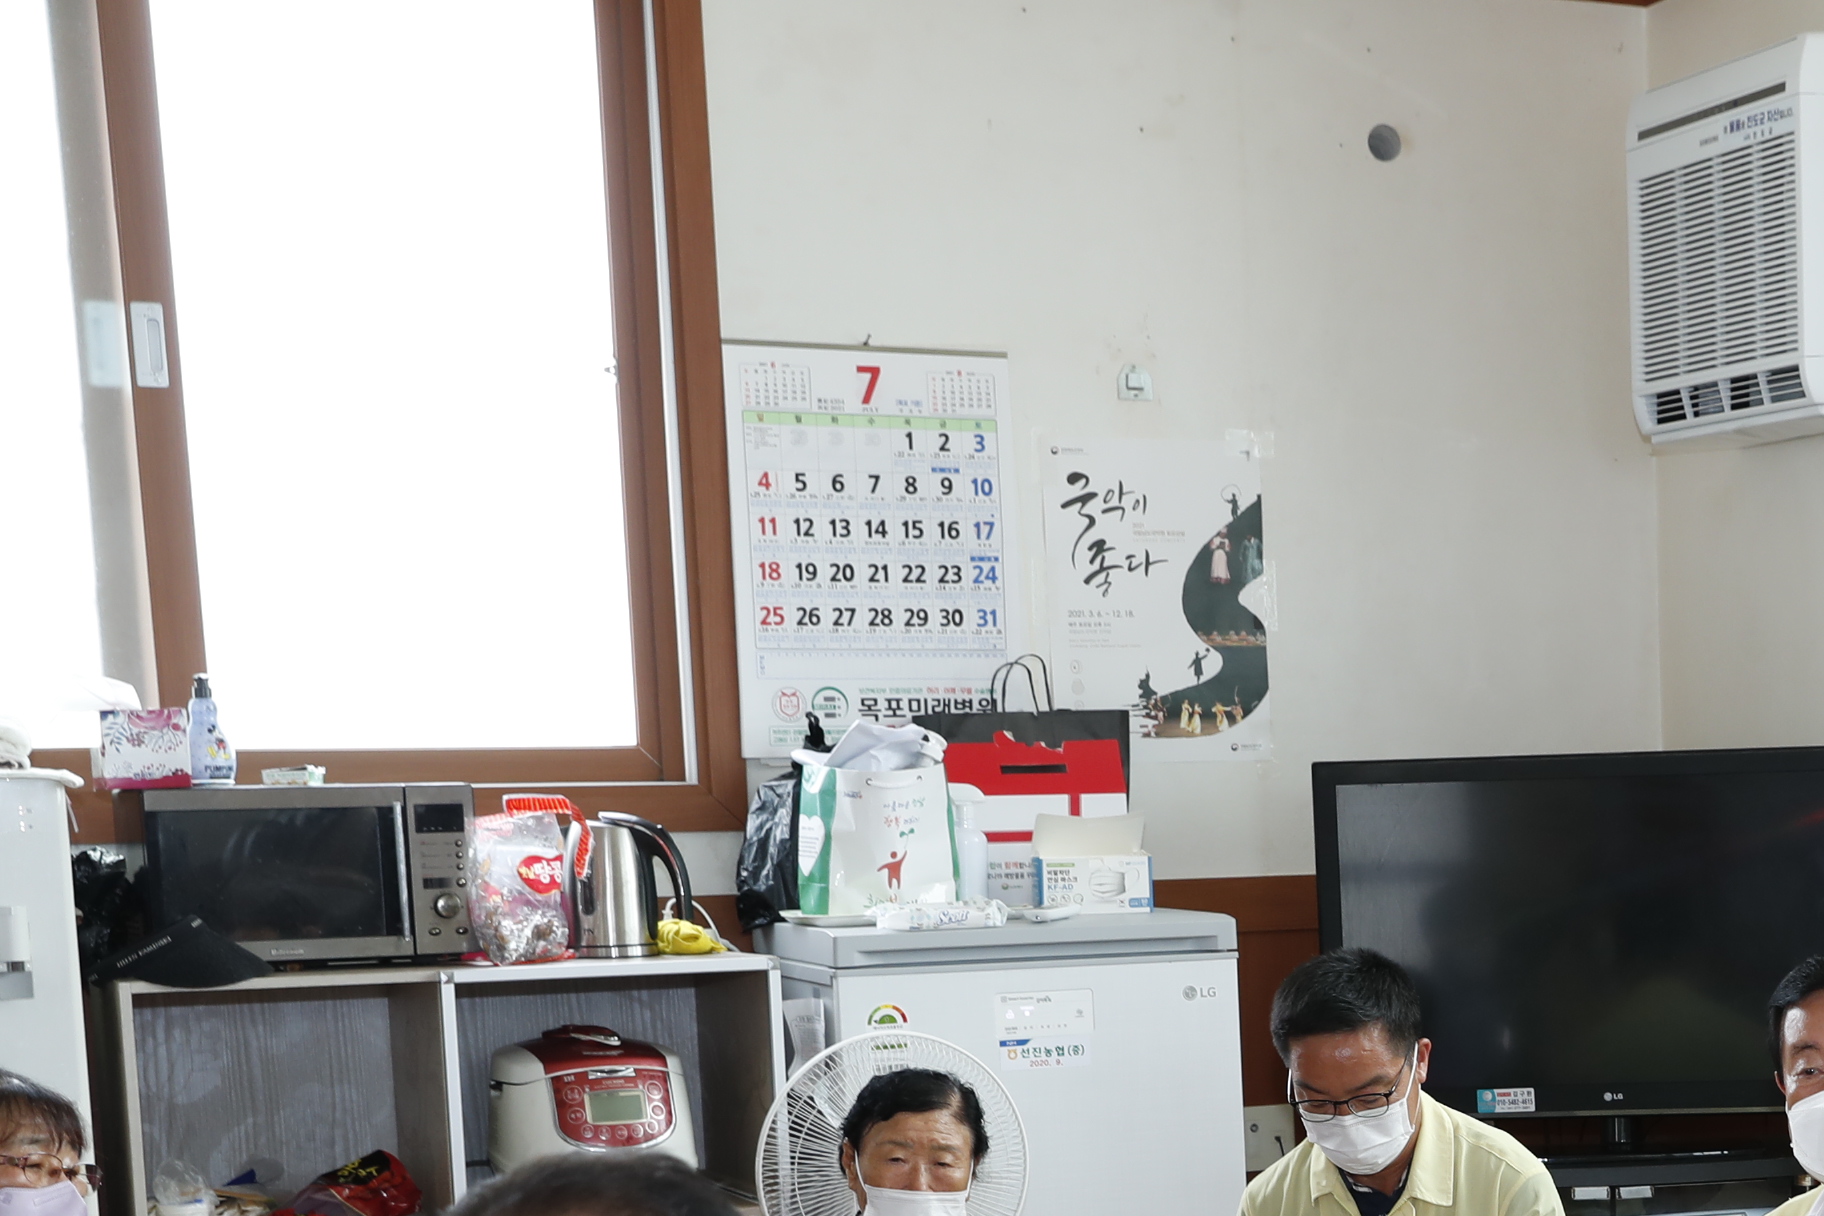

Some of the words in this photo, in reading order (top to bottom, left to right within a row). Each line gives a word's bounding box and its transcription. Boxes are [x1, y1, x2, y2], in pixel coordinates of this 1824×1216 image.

[856, 364, 881, 405] 7
[905, 432, 914, 450] 1
[938, 433, 951, 452] 2
[973, 434, 986, 452] 3
[757, 471, 772, 491] 4
[794, 472, 807, 492] 5
[831, 474, 845, 493] 6
[867, 475, 881, 494] 7
[904, 476, 918, 494] 8
[940, 477, 953, 496] 9
[971, 478, 993, 496] 10
[1060, 471, 1147, 560] 국악이
[757, 516, 778, 536] 11
[793, 517, 815, 537] 12
[828, 518, 851, 538] 13
[864, 519, 888, 539] 14
[901, 520, 924, 539] 15
[937, 521, 961, 540] 16
[973, 521, 995, 540] 17
[758, 561, 782, 581] 18
[795, 562, 818, 582] 19
[829, 563, 855, 582] 20
[867, 564, 889, 583] 21
[901, 564, 926, 583] 22
[937, 565, 962, 584] 23
[972, 565, 998, 584] 24
[1084, 538, 1168, 598] 좋다
[759, 606, 785, 626] 25
[796, 607, 821, 626] 26
[832, 607, 856, 626] 27
[867, 608, 893, 627] 28
[904, 608, 928, 627] 29
[939, 609, 964, 627] 30
[976, 609, 997, 627] 31
[1199, 987, 1217, 998] LG
[1029, 1059, 1051, 1068] 2020.
[1055, 1058, 1064, 1066] 9.
